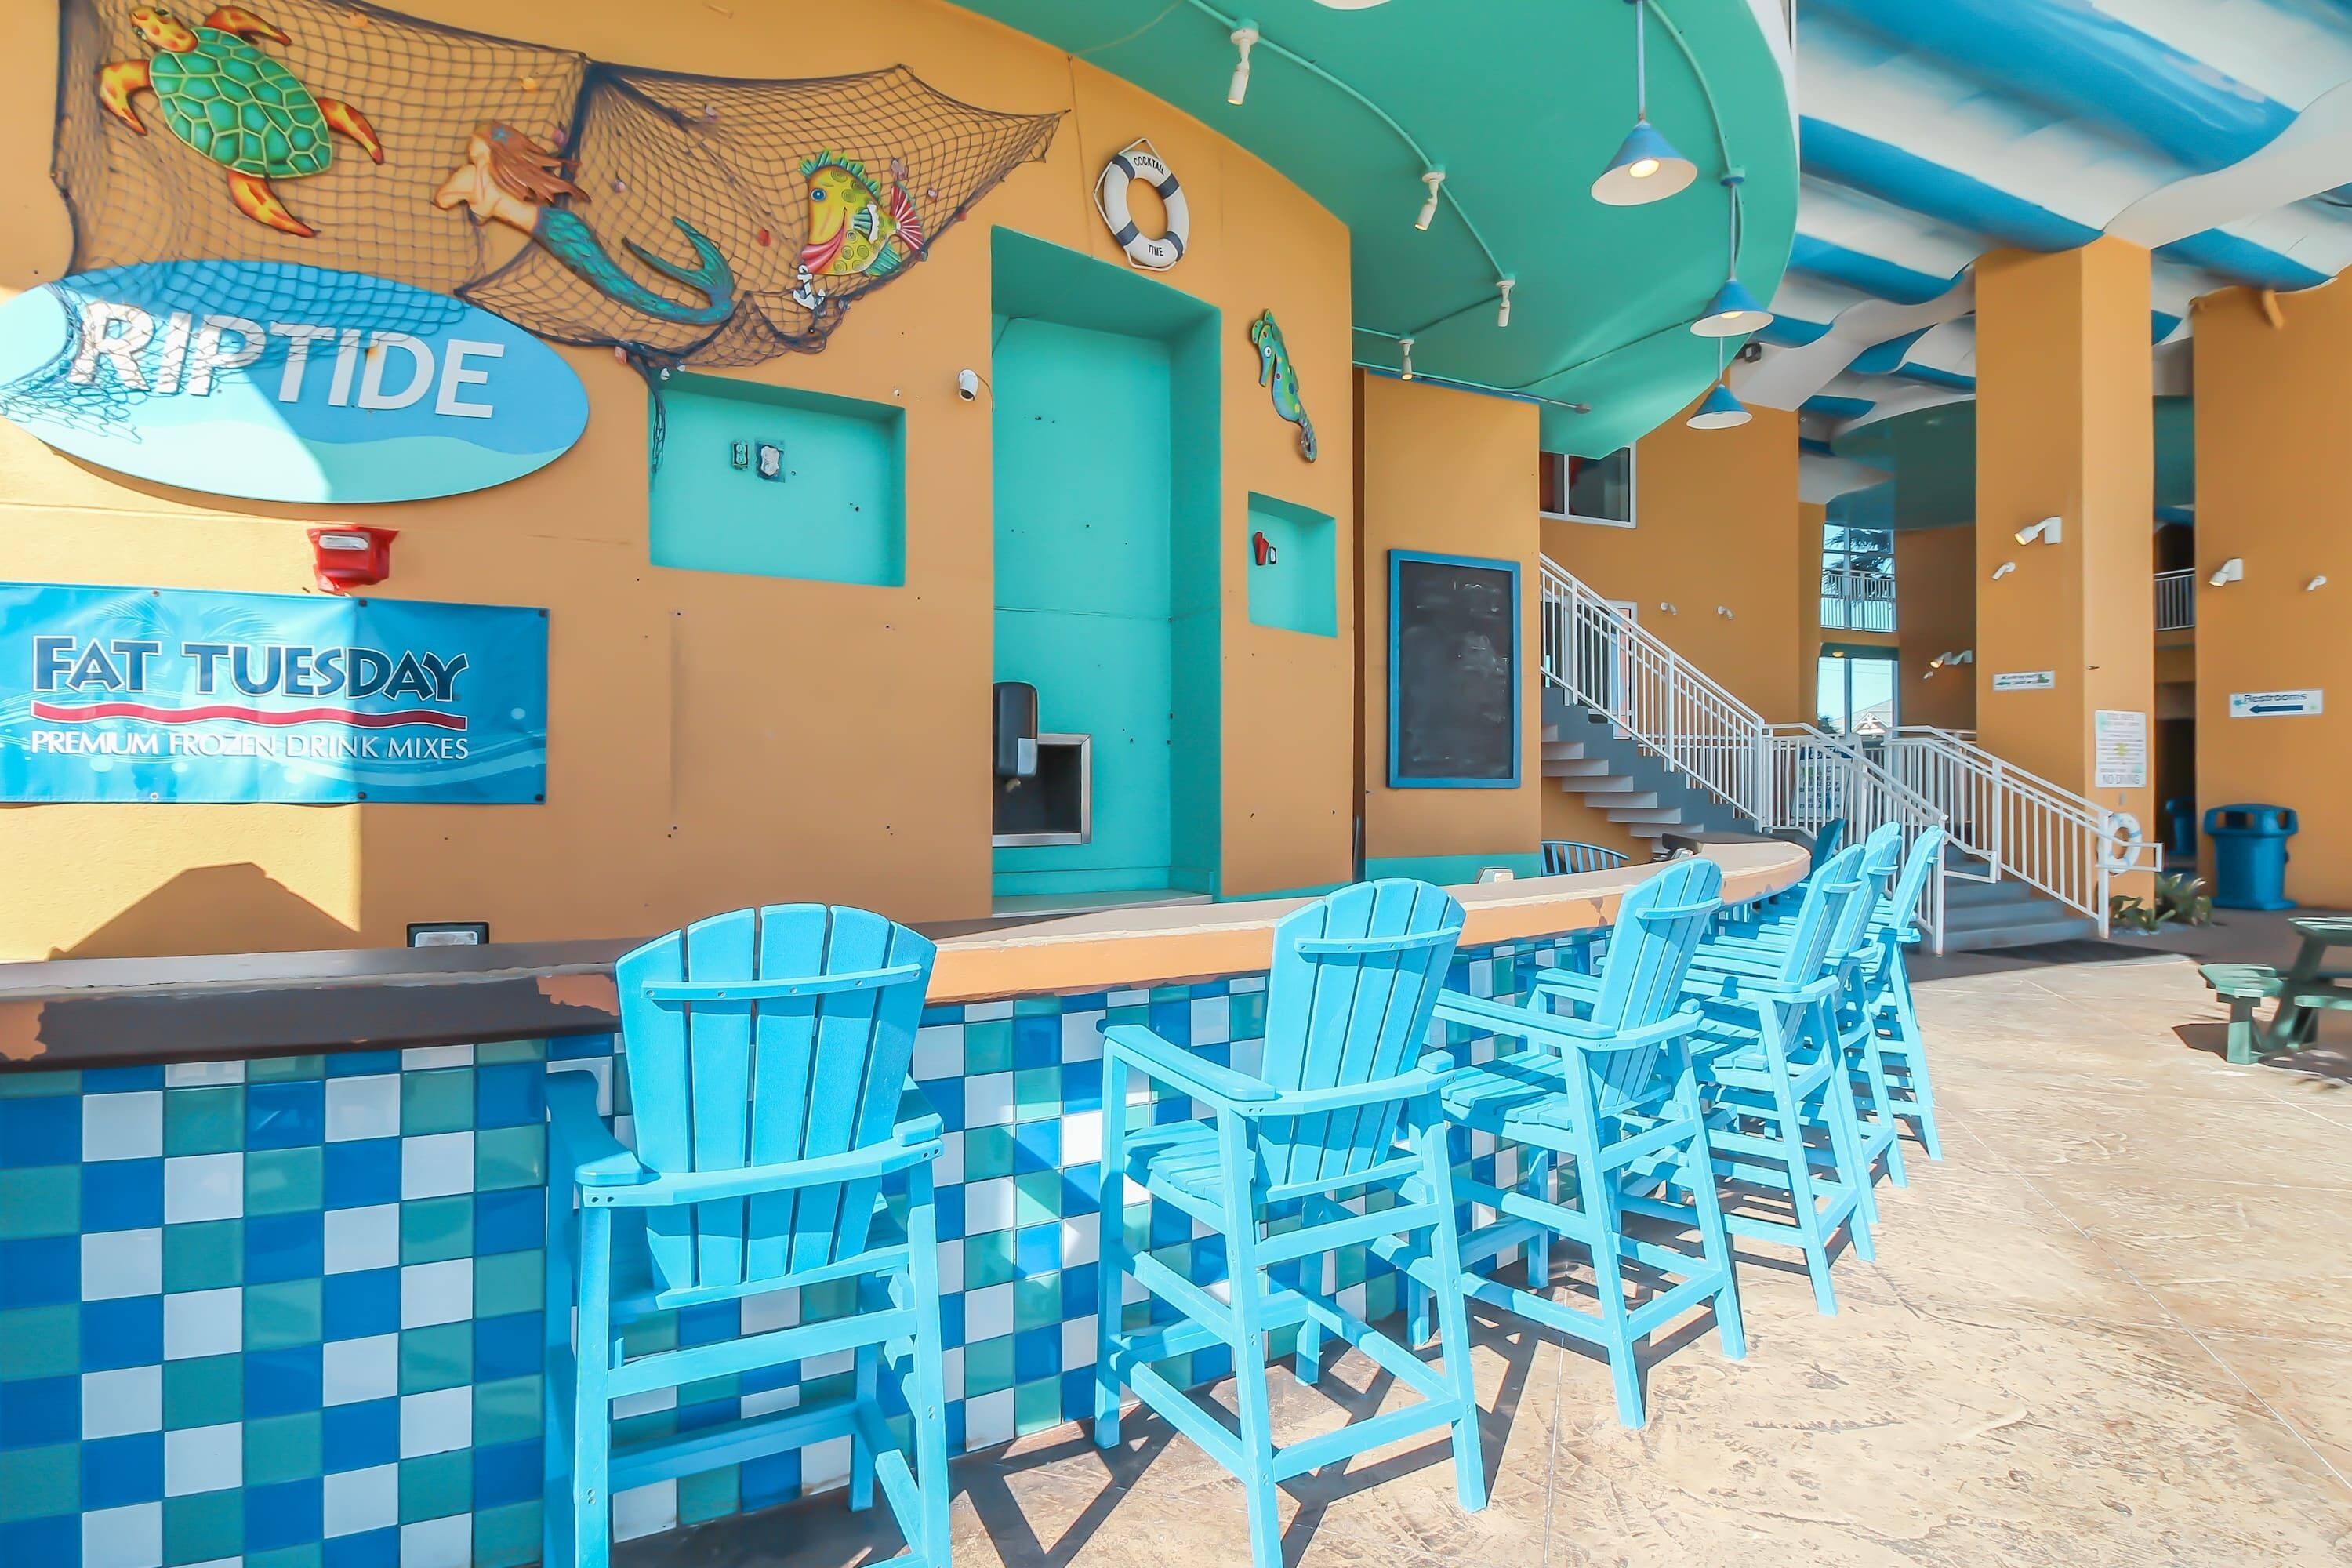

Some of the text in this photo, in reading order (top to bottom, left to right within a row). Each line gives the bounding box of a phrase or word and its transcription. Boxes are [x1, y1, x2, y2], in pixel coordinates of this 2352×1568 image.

[1134, 155, 1164, 176] COCKTAIL
[1148, 244, 1164, 257] TIME
[69, 300, 506, 419] RIPTIDE
[33, 635, 469, 702] FAT TUESDAY
[2245, 693, 2307, 702] Restrooms
[31, 730, 470, 760] PREMIUM FROZEN DRINK MIXES
